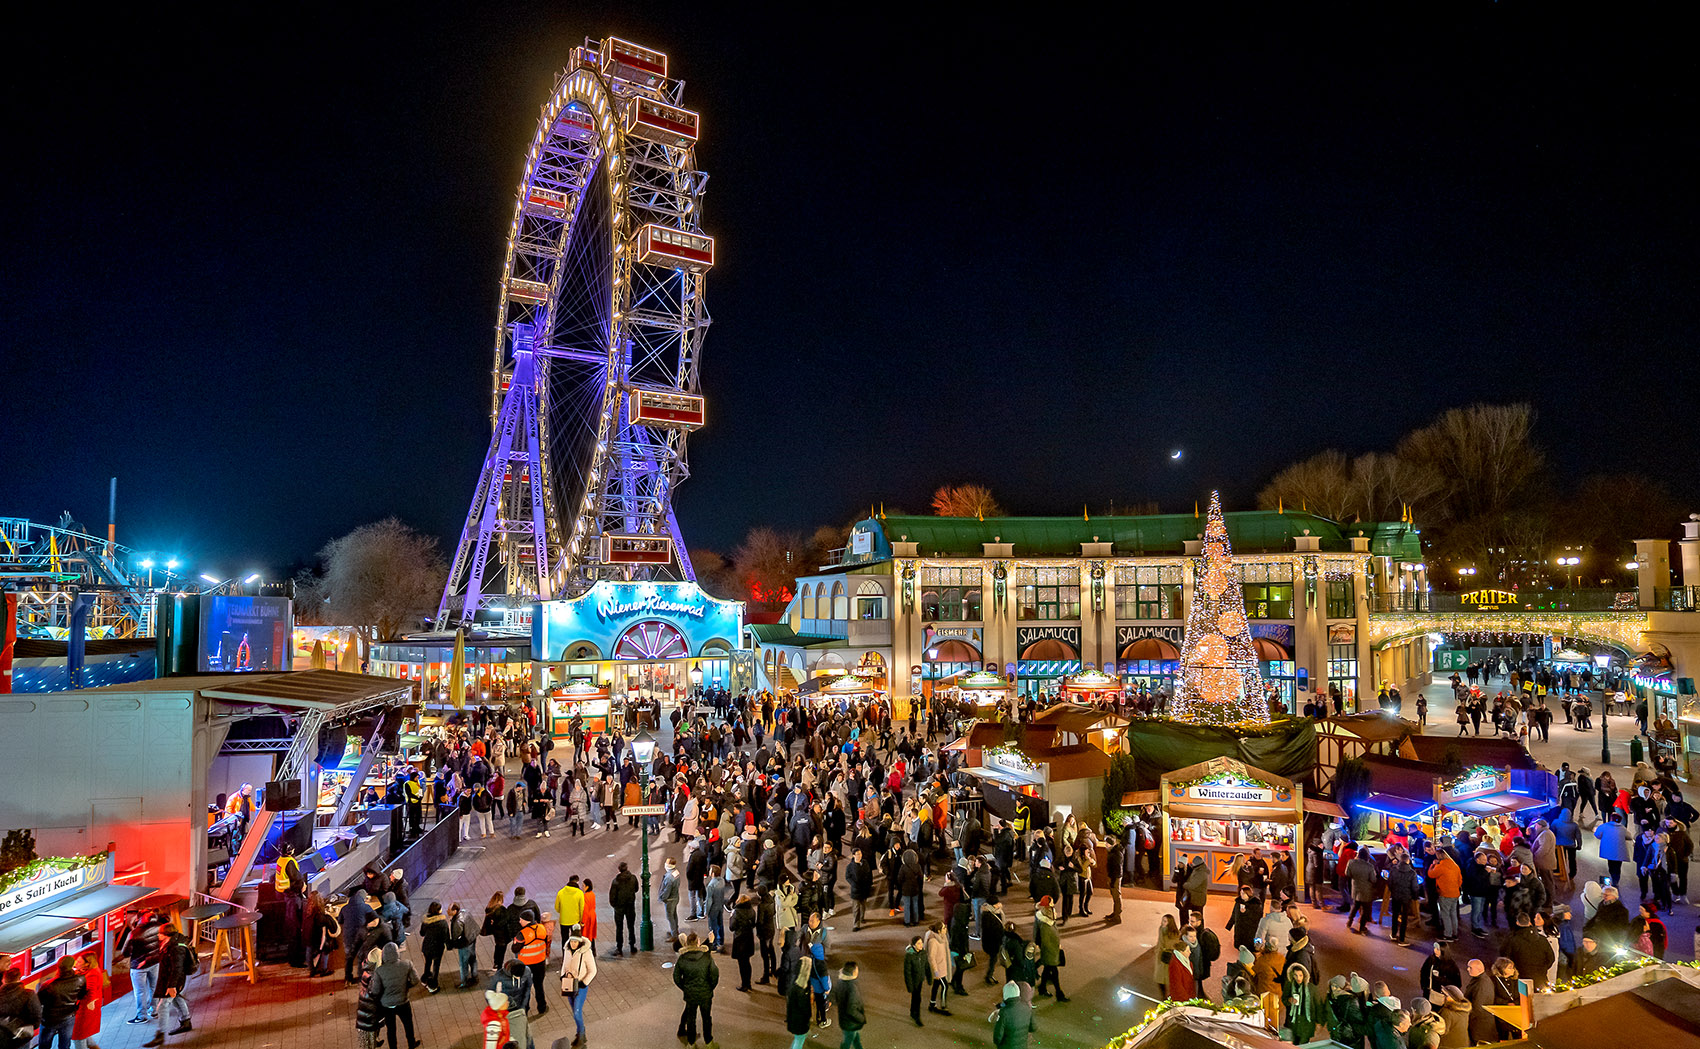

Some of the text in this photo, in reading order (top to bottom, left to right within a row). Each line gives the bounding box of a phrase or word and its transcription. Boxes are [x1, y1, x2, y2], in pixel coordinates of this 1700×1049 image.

[1460, 589, 1519, 604] PRATER
[597, 595, 705, 617] Wiener Riesenrad
[1019, 627, 1079, 645] SALAMUCCI
[1119, 627, 1181, 645] SALAMUCCI
[1198, 788, 1263, 800] Winterzauber
[623, 806, 665, 814] RIESENRADPLATZ
[0, 900, 12, 912] pe
[14, 893, 24, 904] &
[53, 874, 78, 890] Kuchl
